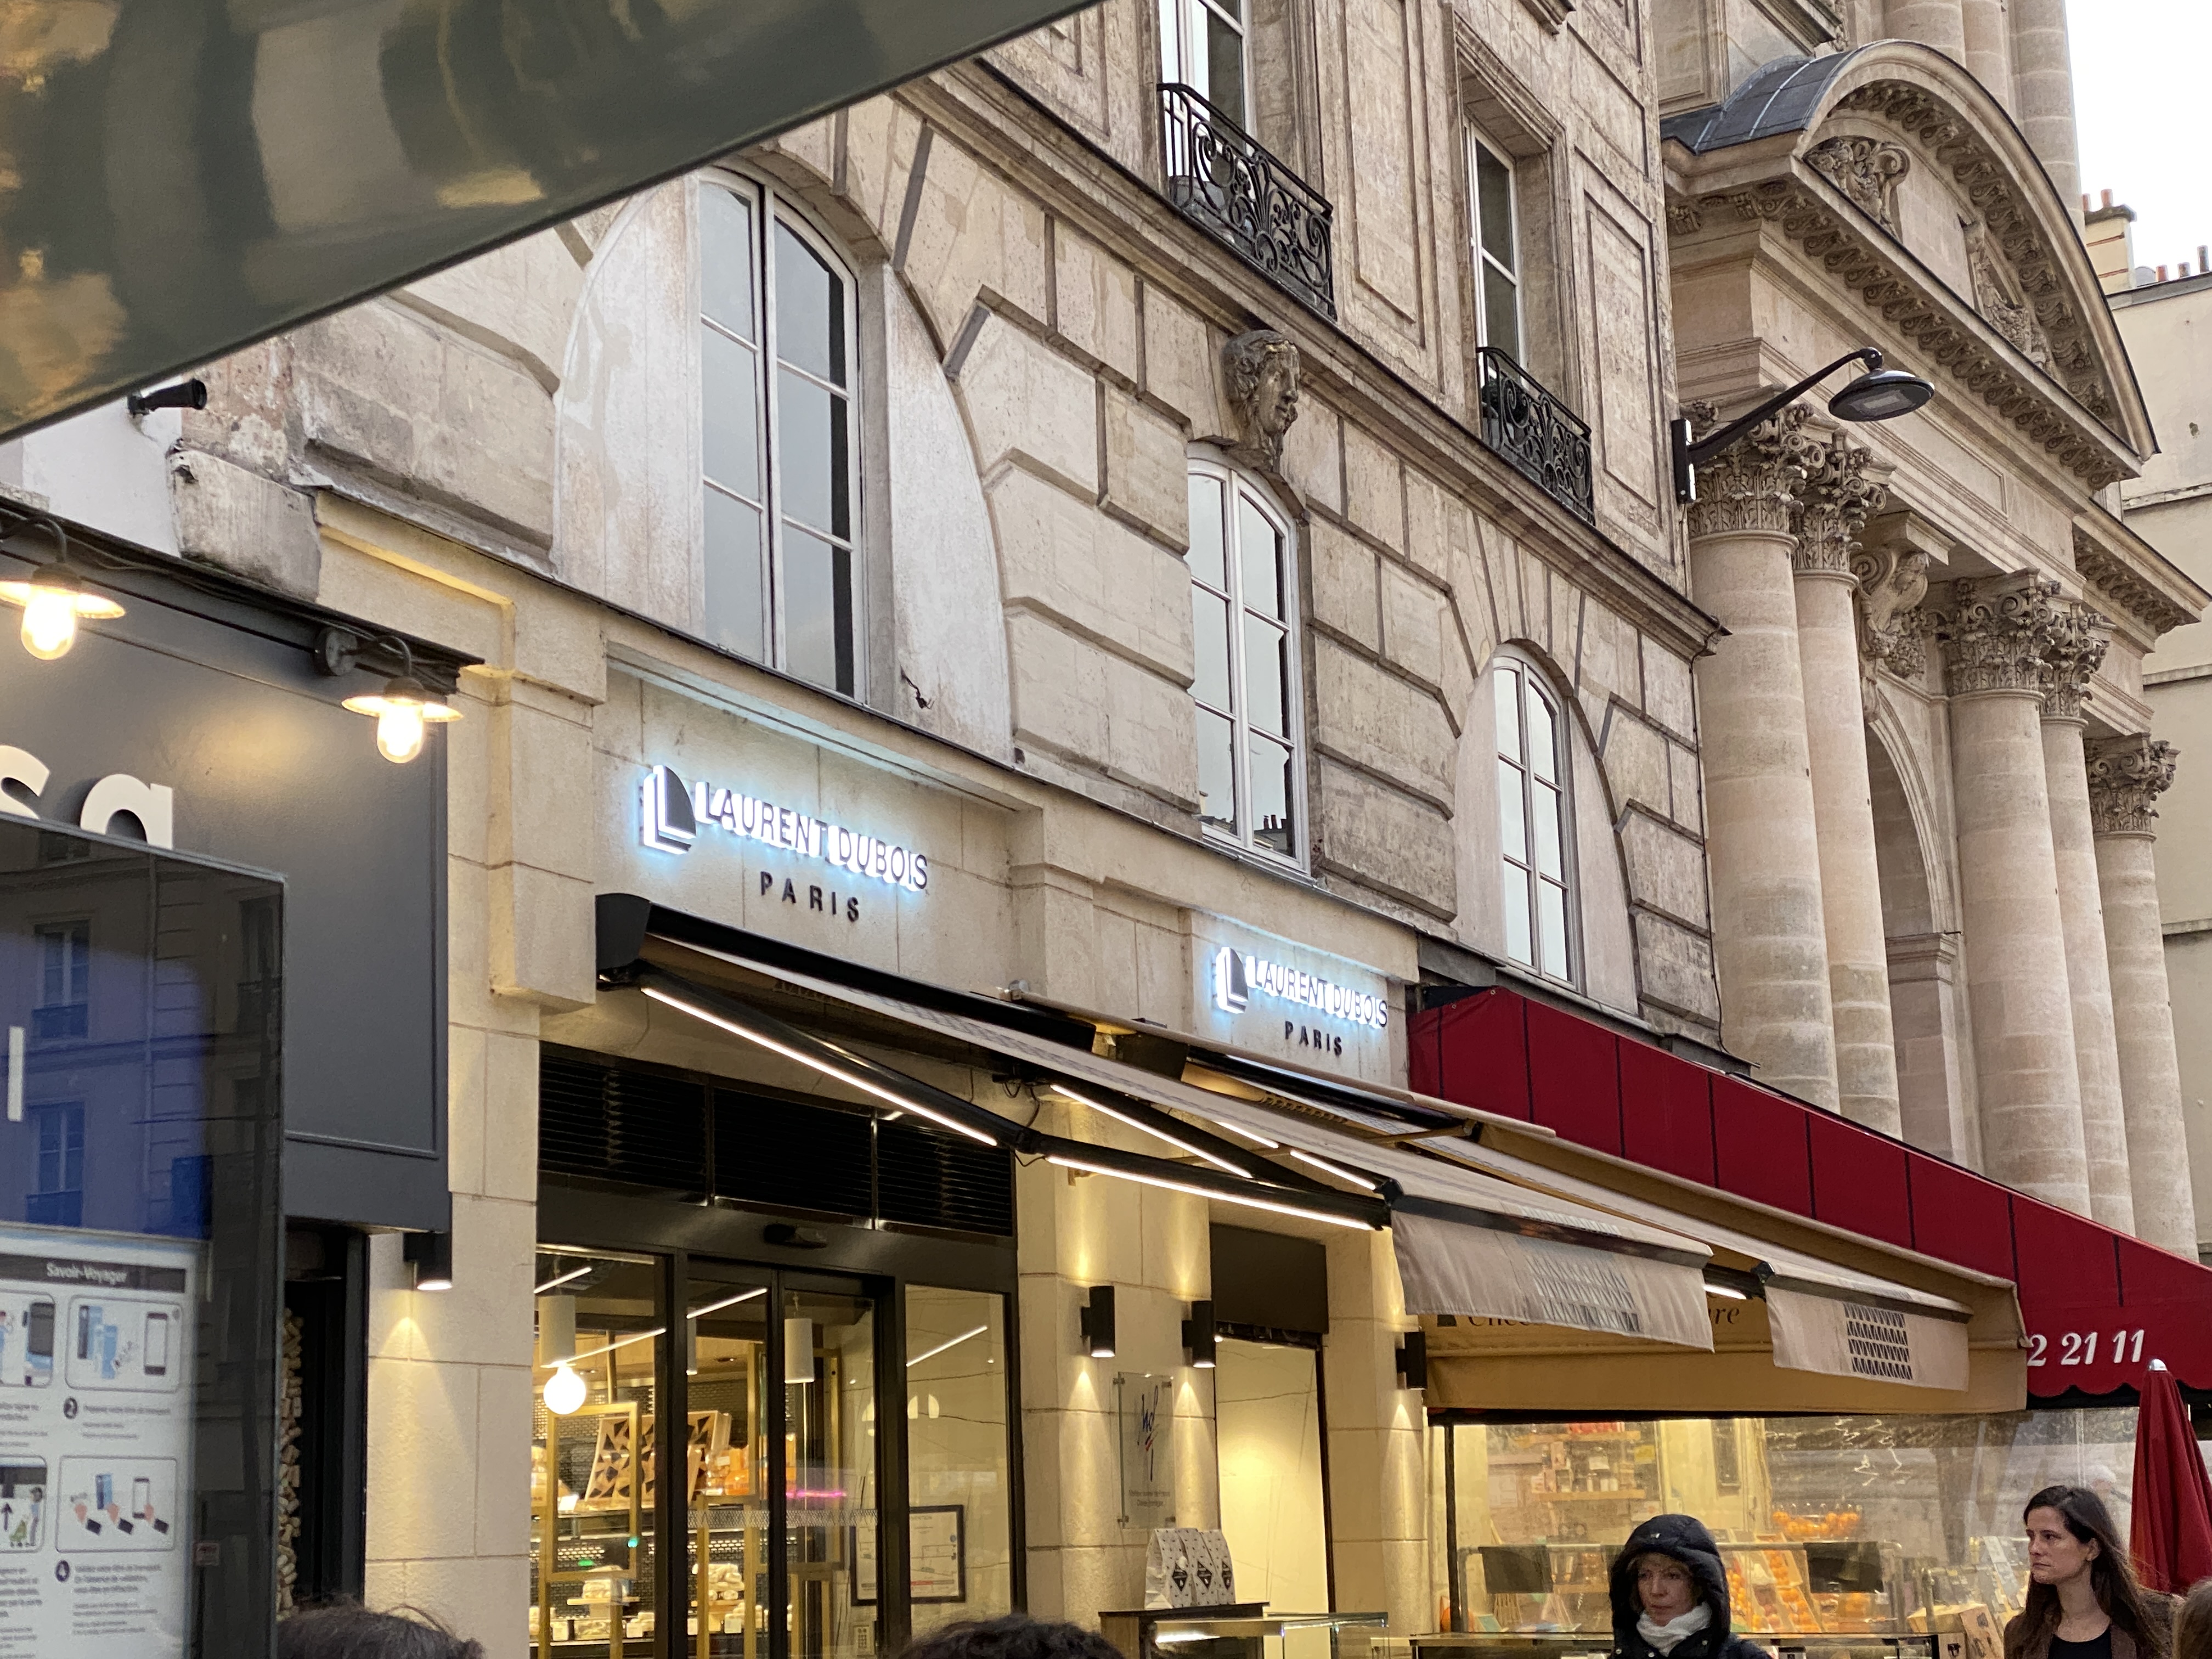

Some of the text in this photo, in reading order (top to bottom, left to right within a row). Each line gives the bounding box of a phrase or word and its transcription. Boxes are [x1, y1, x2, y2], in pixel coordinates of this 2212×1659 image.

[696, 781, 928, 891] LAURENT DUBOIS
[760, 871, 860, 922] PARIS
[1245, 956, 1387, 1029] LAURENT DUBOIS
[1285, 1020, 1342, 1057] PARIS
[2061, 1331, 2098, 1365] 21
[2113, 1329, 2145, 1364] 11
